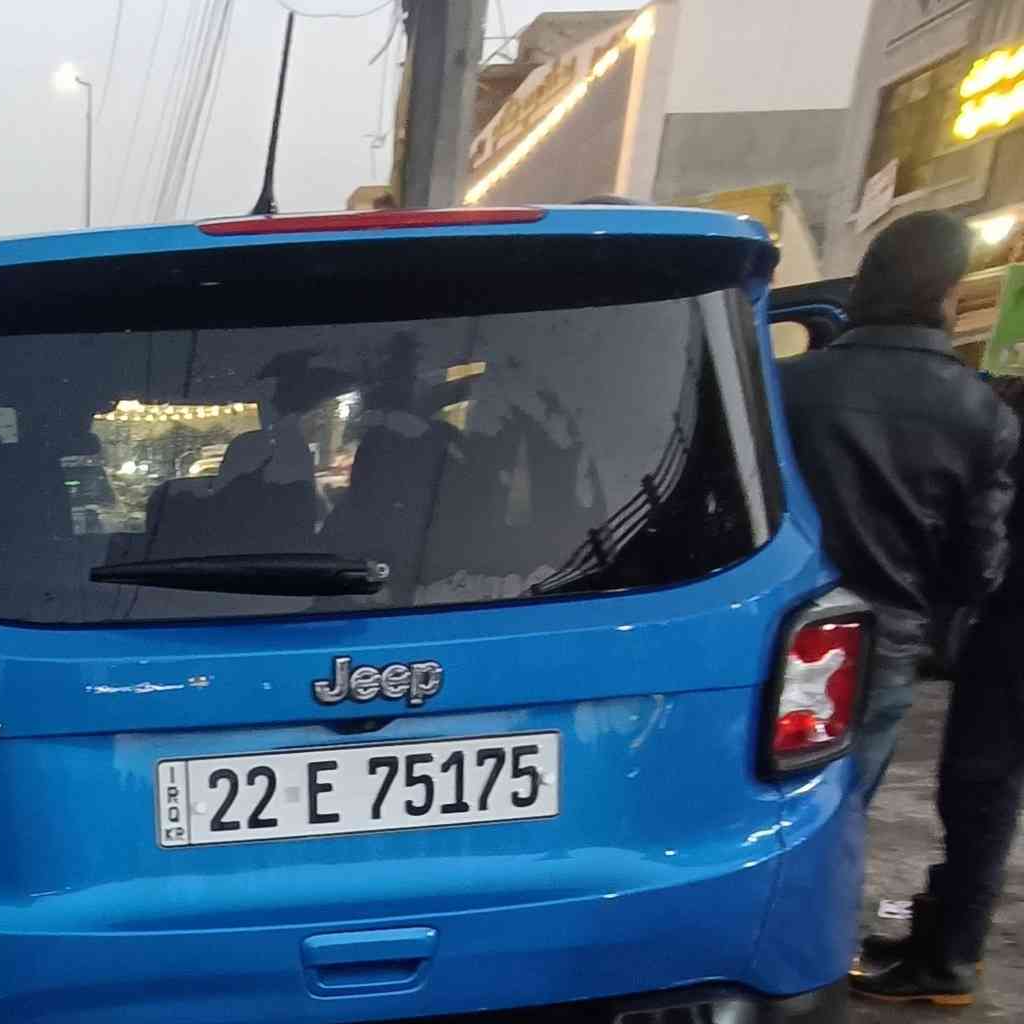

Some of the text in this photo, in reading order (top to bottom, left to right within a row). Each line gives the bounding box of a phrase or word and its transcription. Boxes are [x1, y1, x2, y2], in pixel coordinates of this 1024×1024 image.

[313, 656, 443, 705] Jeep
[207, 744, 539, 833] 22 E 75175
